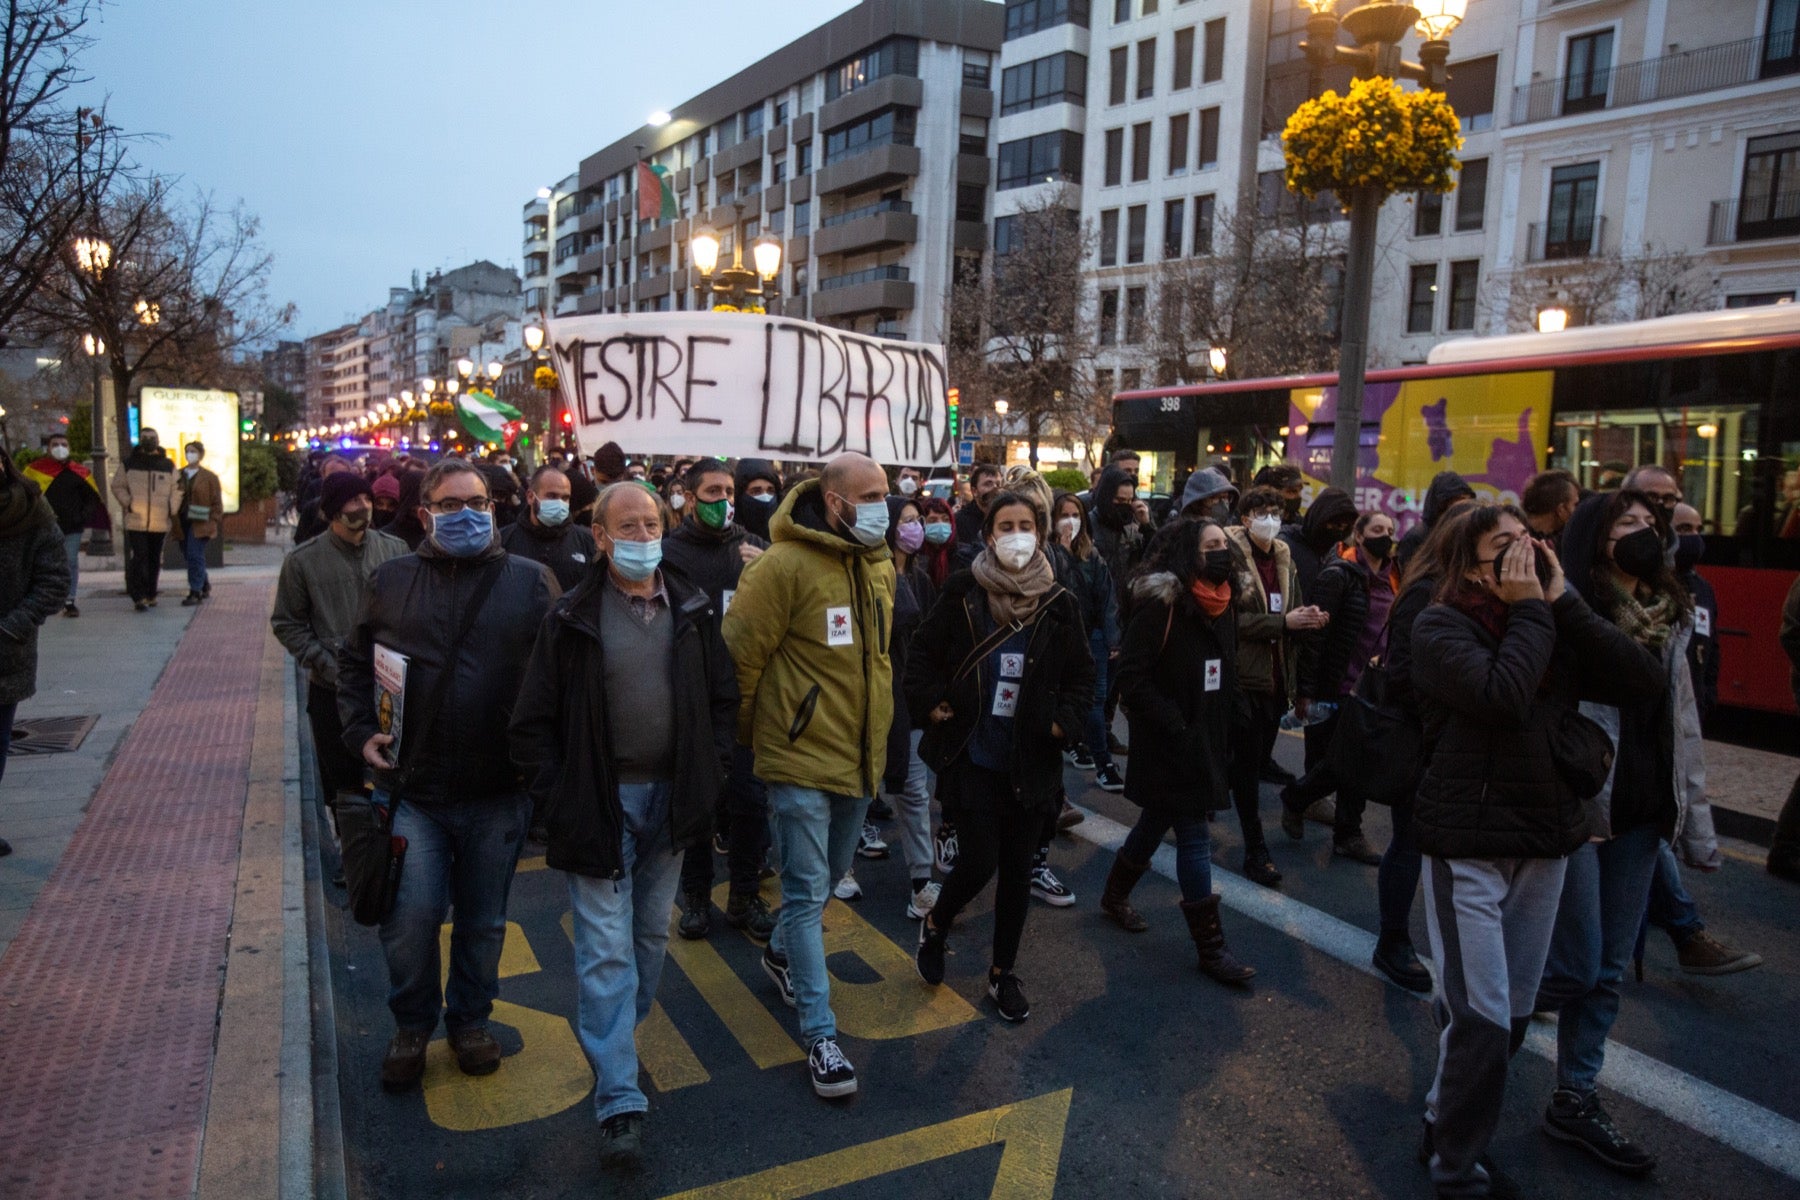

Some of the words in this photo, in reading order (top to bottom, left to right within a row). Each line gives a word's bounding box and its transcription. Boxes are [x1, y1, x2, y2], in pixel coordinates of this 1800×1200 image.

[555, 332, 731, 427] MESTRE
[758, 322, 952, 464] LIBERTAD
[1160, 396, 1181, 413] 398
